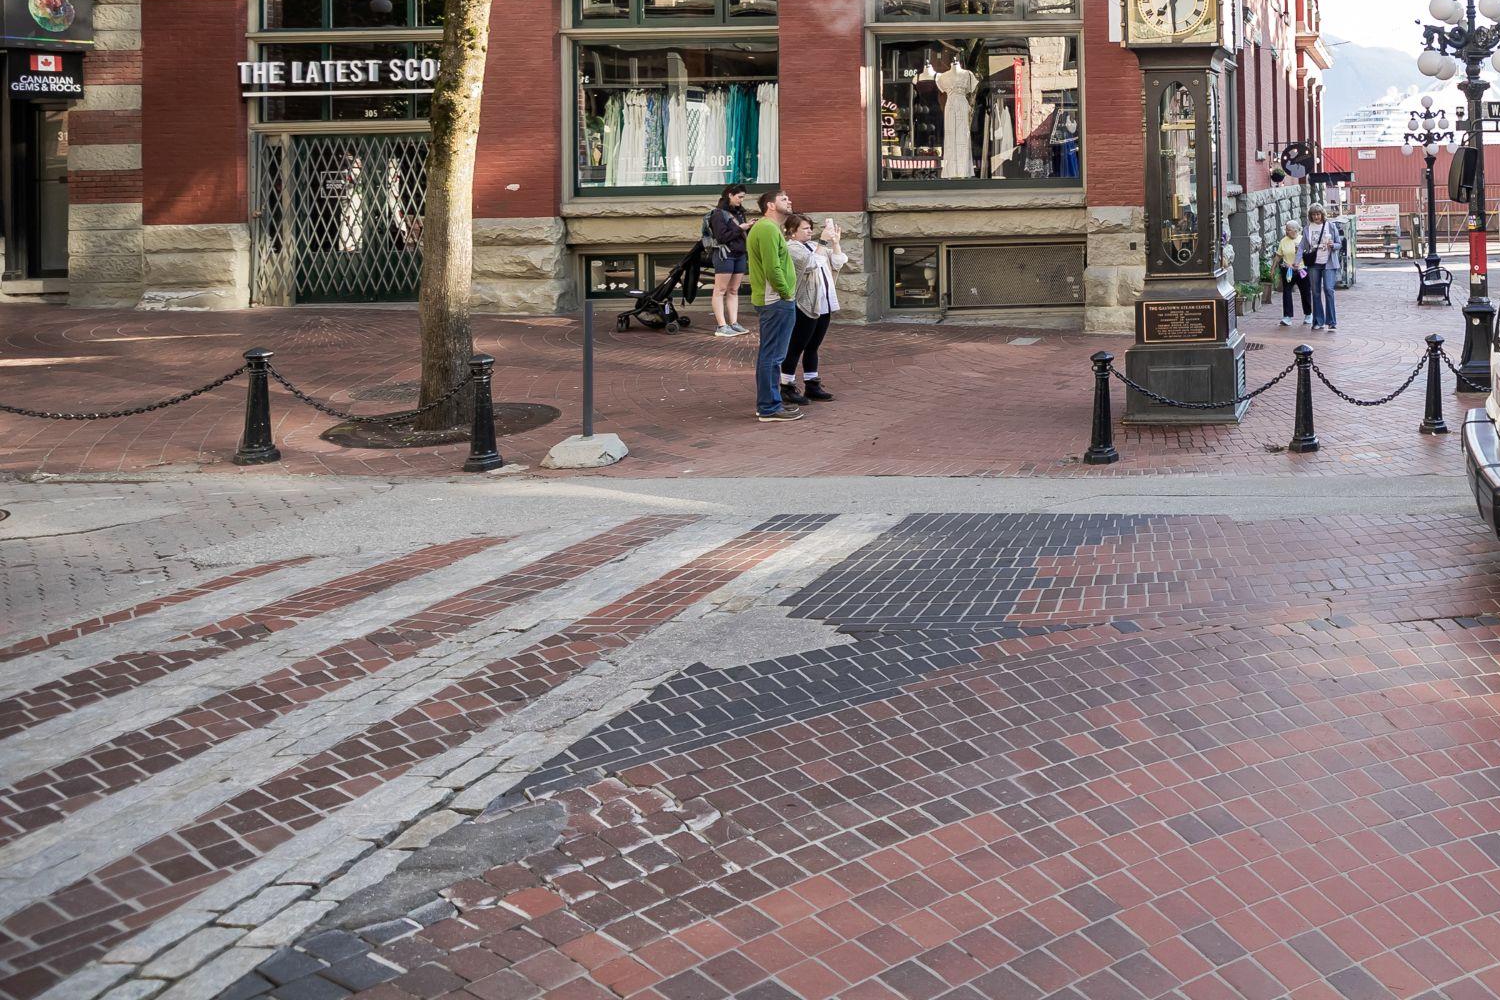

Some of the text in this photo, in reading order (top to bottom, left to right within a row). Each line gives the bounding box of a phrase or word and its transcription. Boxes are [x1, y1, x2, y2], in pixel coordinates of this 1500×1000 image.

[237, 58, 441, 84] THE LATEST SCO
[20, 75, 74, 85] CANADIAN
[11, 82, 81, 92] GEMS & ROCKS
[364, 109, 378, 118] 305
